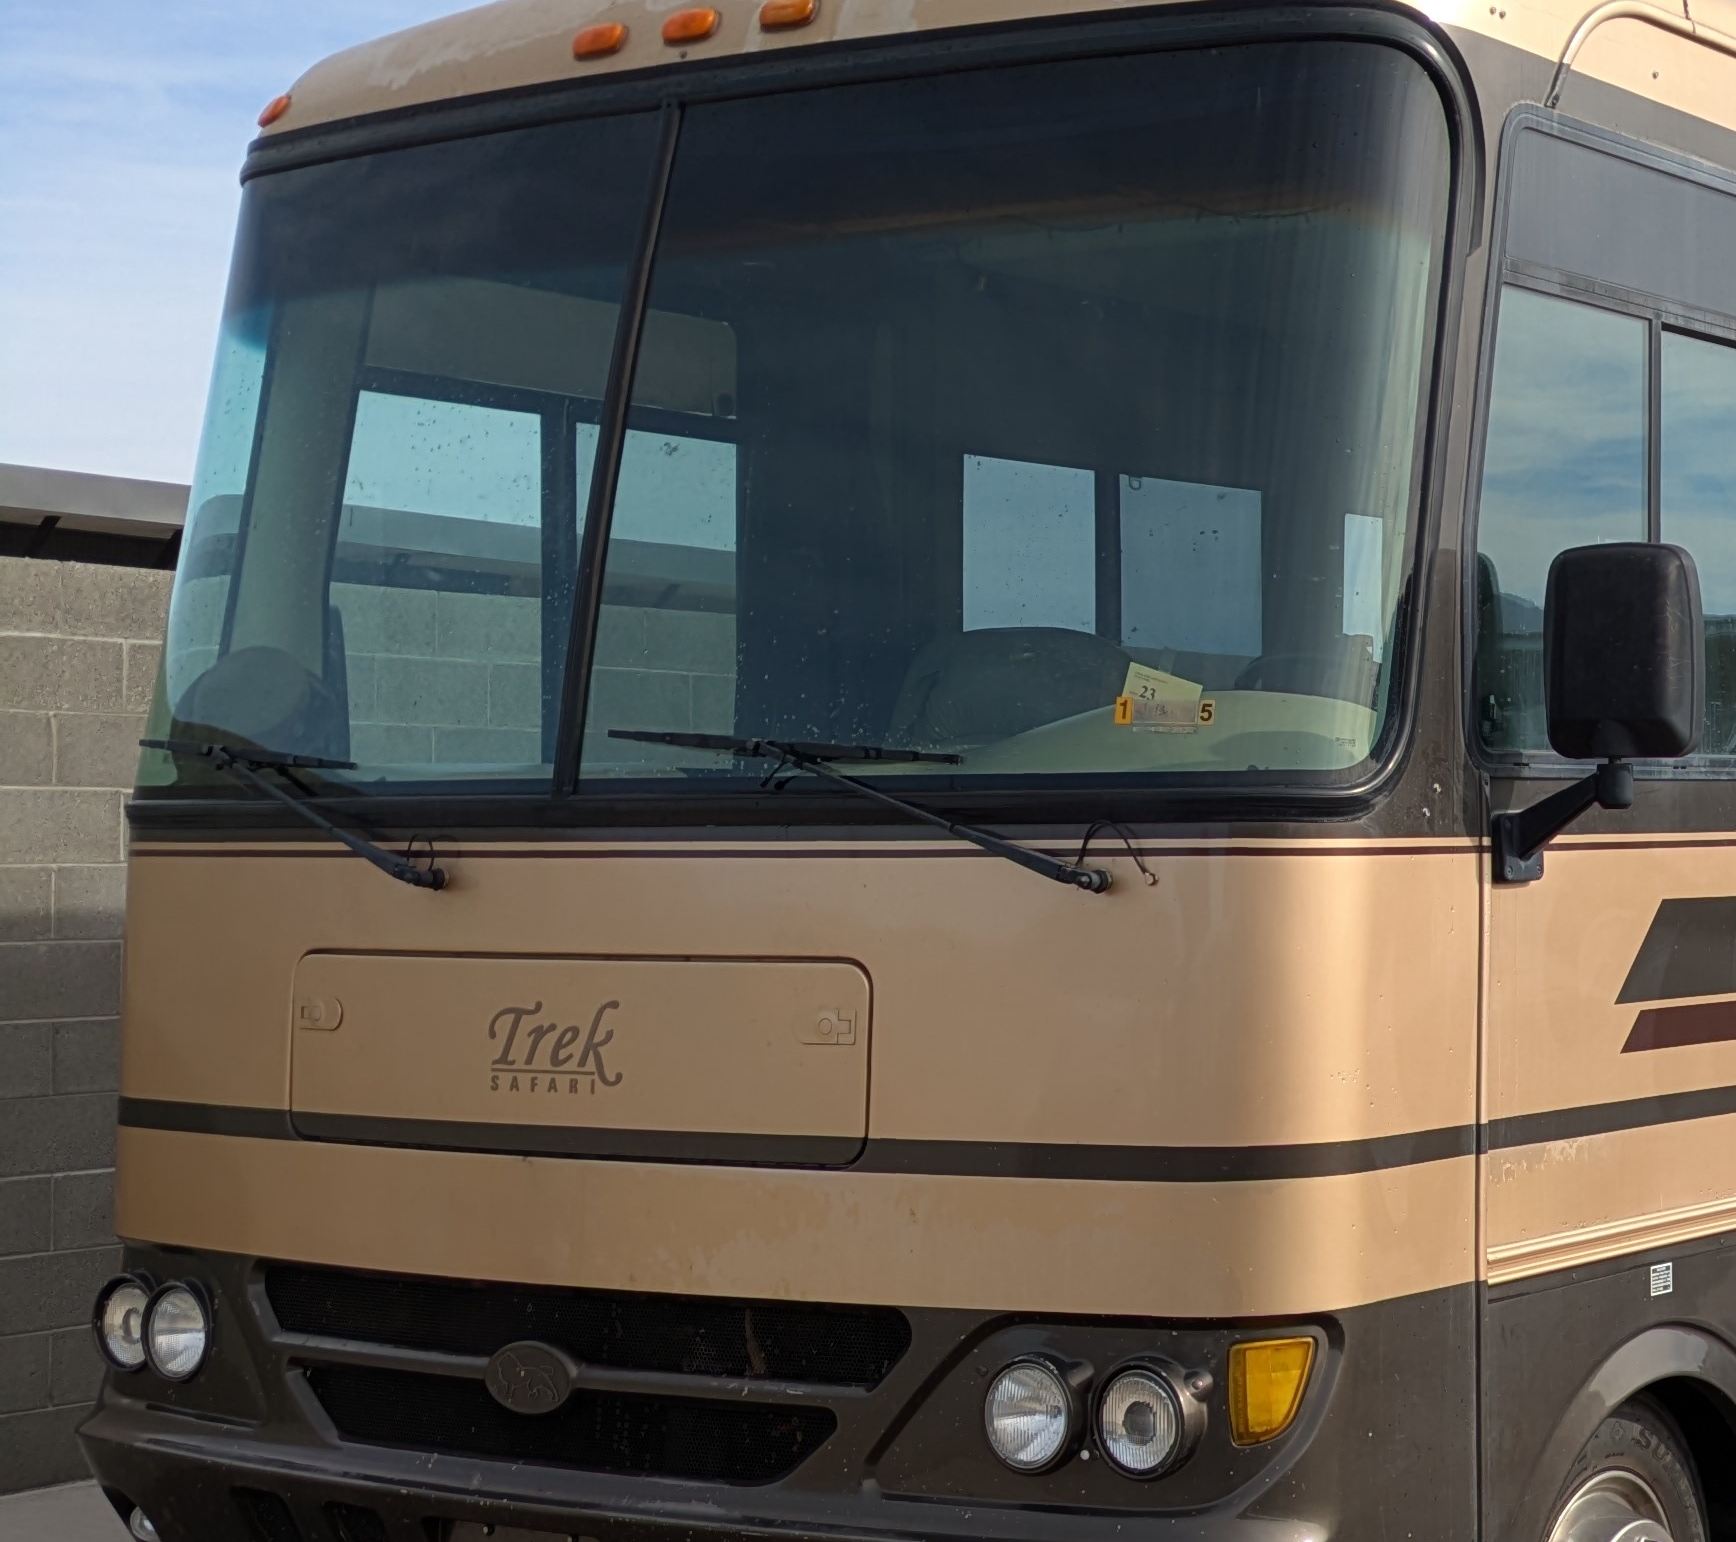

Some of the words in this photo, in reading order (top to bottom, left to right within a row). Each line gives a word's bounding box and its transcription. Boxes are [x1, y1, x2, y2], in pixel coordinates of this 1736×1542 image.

[1119, 700, 1128, 720] 1
[1200, 704, 1213, 721] 5
[488, 1000, 623, 1087] Trek
[490, 1074, 596, 1095] SAFARI
